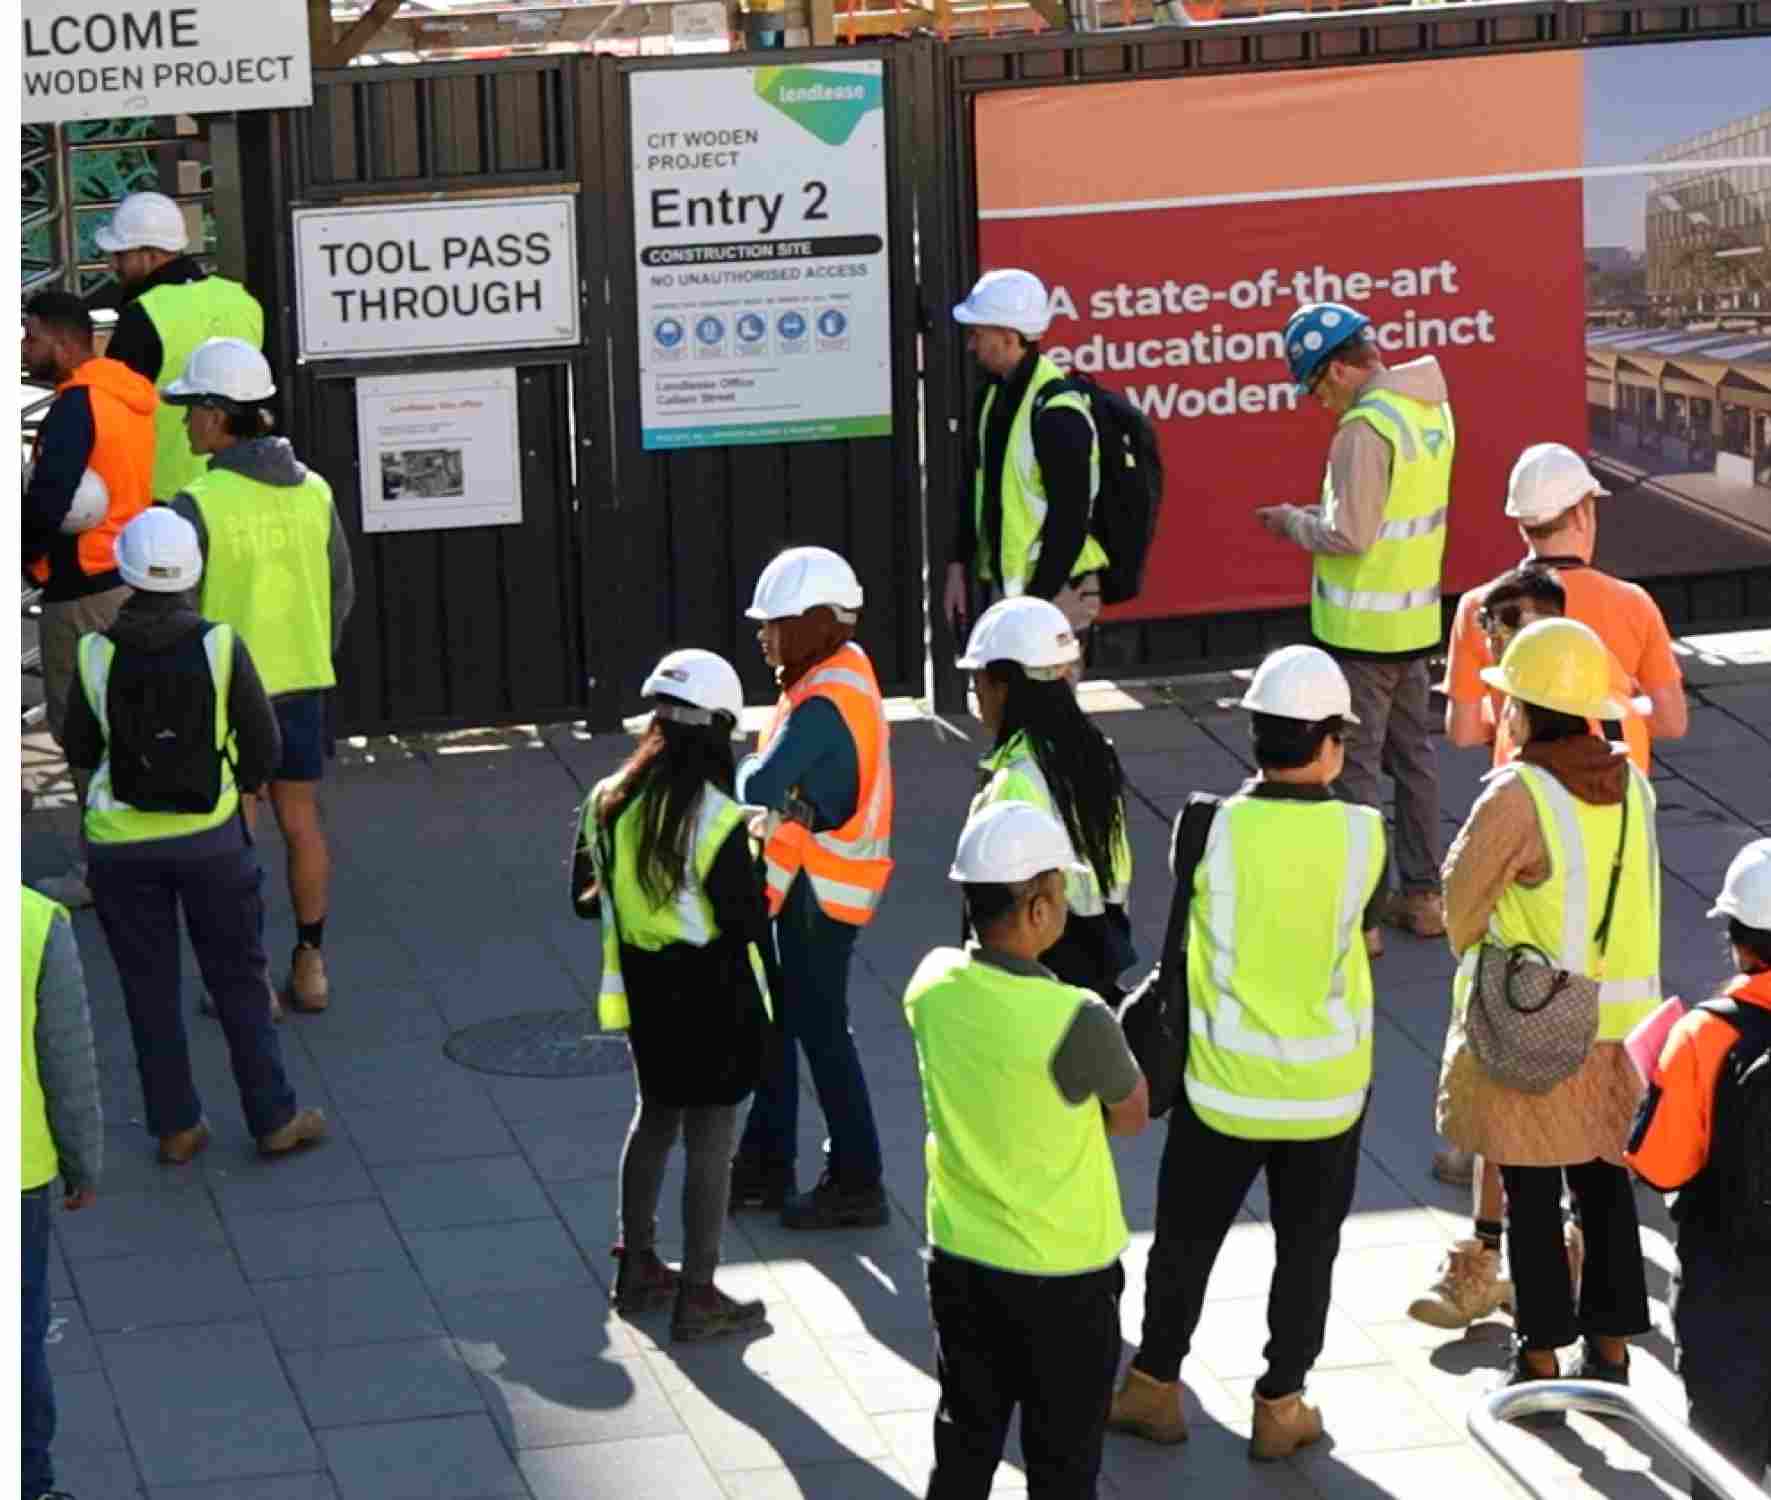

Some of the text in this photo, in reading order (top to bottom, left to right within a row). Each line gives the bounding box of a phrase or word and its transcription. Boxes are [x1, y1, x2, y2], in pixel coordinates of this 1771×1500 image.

[24, 8, 199, 57] LCOME
[24, 55, 295, 97] WODEN PROJECT
[647, 128, 759, 149] CIT WODEN
[647, 150, 740, 171] PROJECT
[650, 180, 829, 234] Entry 2
[319, 231, 552, 278] TOOL PASS
[649, 240, 813, 264] CONSTRUCTION SITE
[651, 263, 869, 288] NO UNAUTHORISED ACCESS
[1049, 259, 1460, 321] A state-of-the-art
[331, 279, 543, 323] THROUGH
[1048, 309, 1497, 373] education cinct
[1124, 377, 1297, 420] Woden
